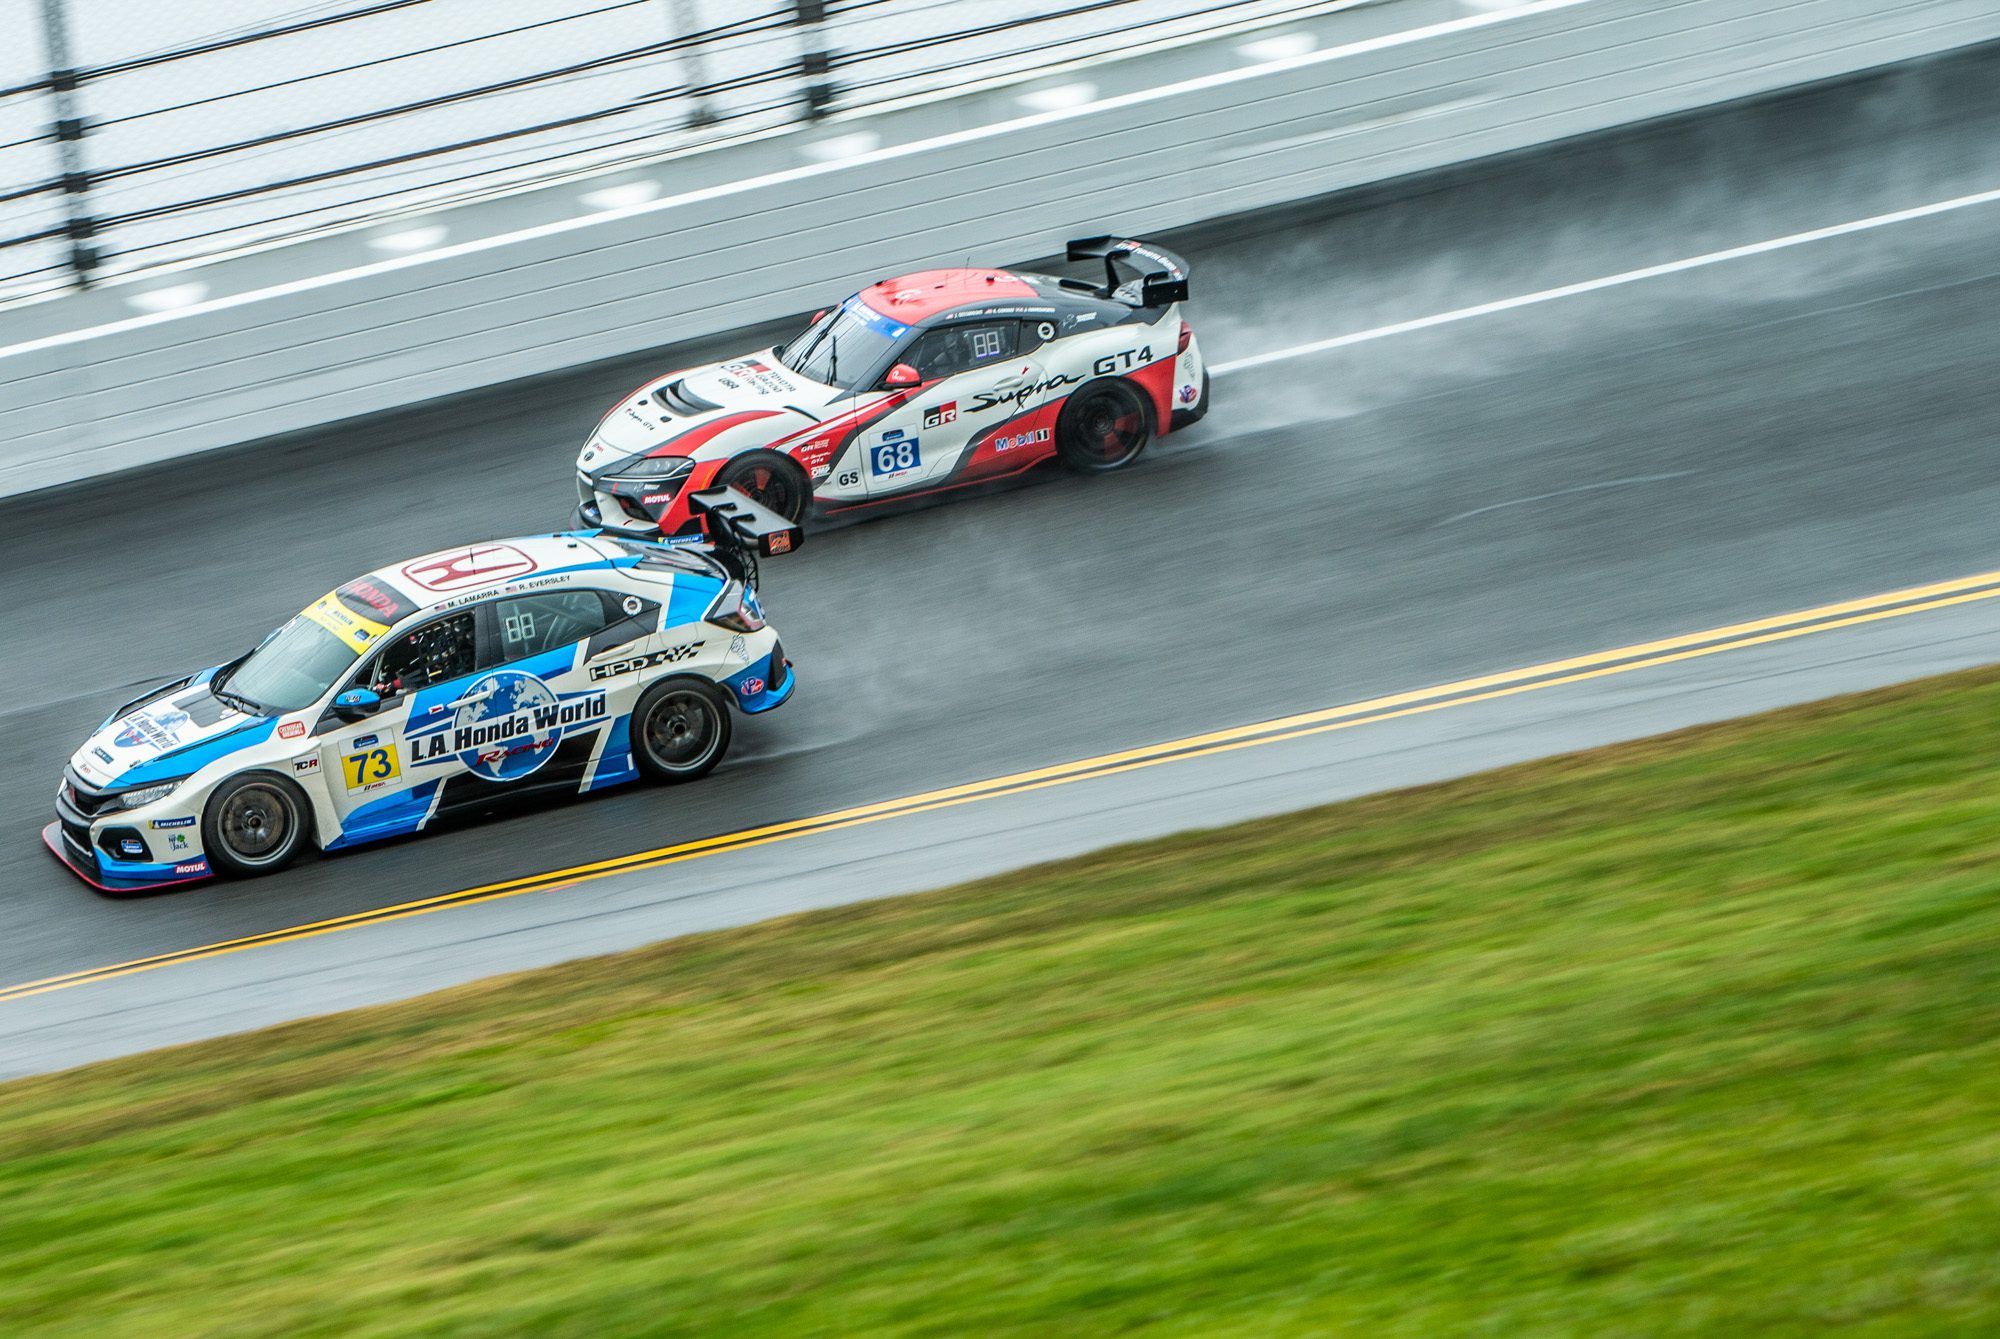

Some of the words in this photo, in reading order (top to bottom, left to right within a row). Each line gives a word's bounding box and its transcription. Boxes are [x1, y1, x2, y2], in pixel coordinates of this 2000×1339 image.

[963, 374, 1086, 413] Supra
[1093, 345, 1153, 376] GT4
[924, 408, 956, 429] GR
[995, 432, 1034, 451] Mobil
[877, 441, 914, 472] 68
[839, 471, 859, 486] GS
[644, 494, 671, 504] MOTUL
[529, 575, 570, 588] EVERSLEY
[459, 590, 499, 605] LAMARRA
[591, 657, 648, 680] HPD
[412, 733, 449, 762] L.A.
[454, 715, 528, 751] Honda
[533, 693, 605, 730] World
[294, 759, 318, 771] TCR
[349, 749, 392, 784] 73
[160, 819, 192, 827] MICHELIN
[176, 863, 205, 873] MOTUL
